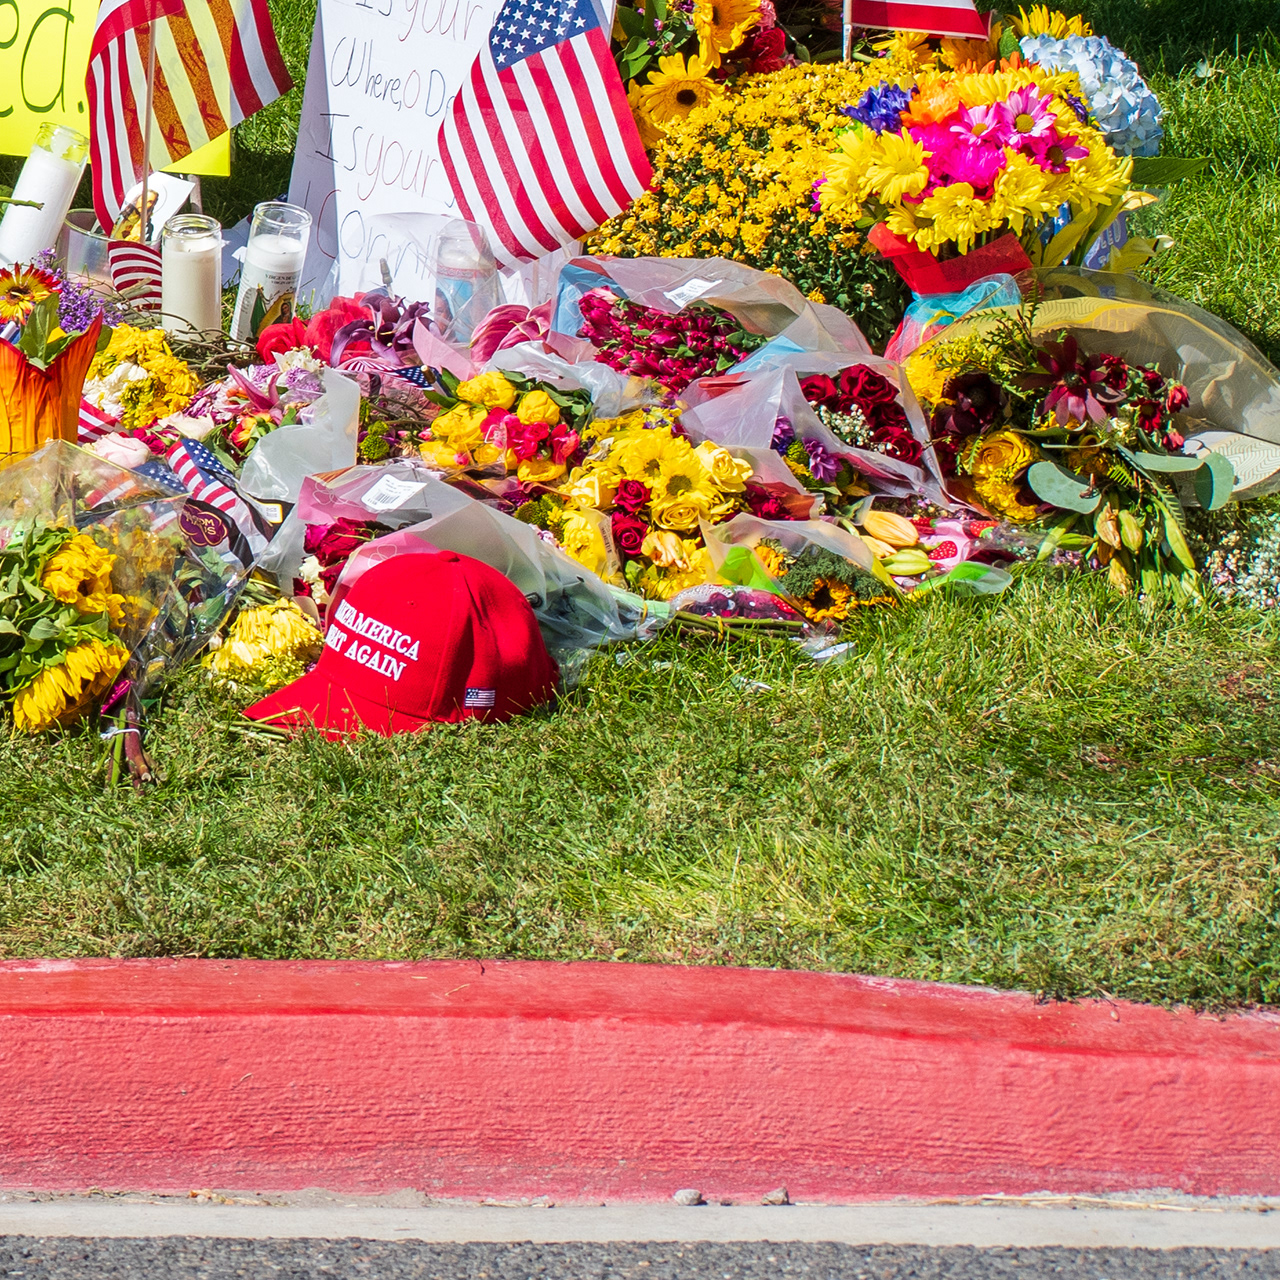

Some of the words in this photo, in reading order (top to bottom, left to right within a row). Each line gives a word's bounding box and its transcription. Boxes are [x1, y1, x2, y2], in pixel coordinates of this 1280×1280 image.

[330, 35, 403, 113] Where,
[315, 112, 364, 172] Is
[356, 127, 439, 202] your
[343, 639, 407, 682] AGAIN
[347, 608, 420, 661] AMERICA
